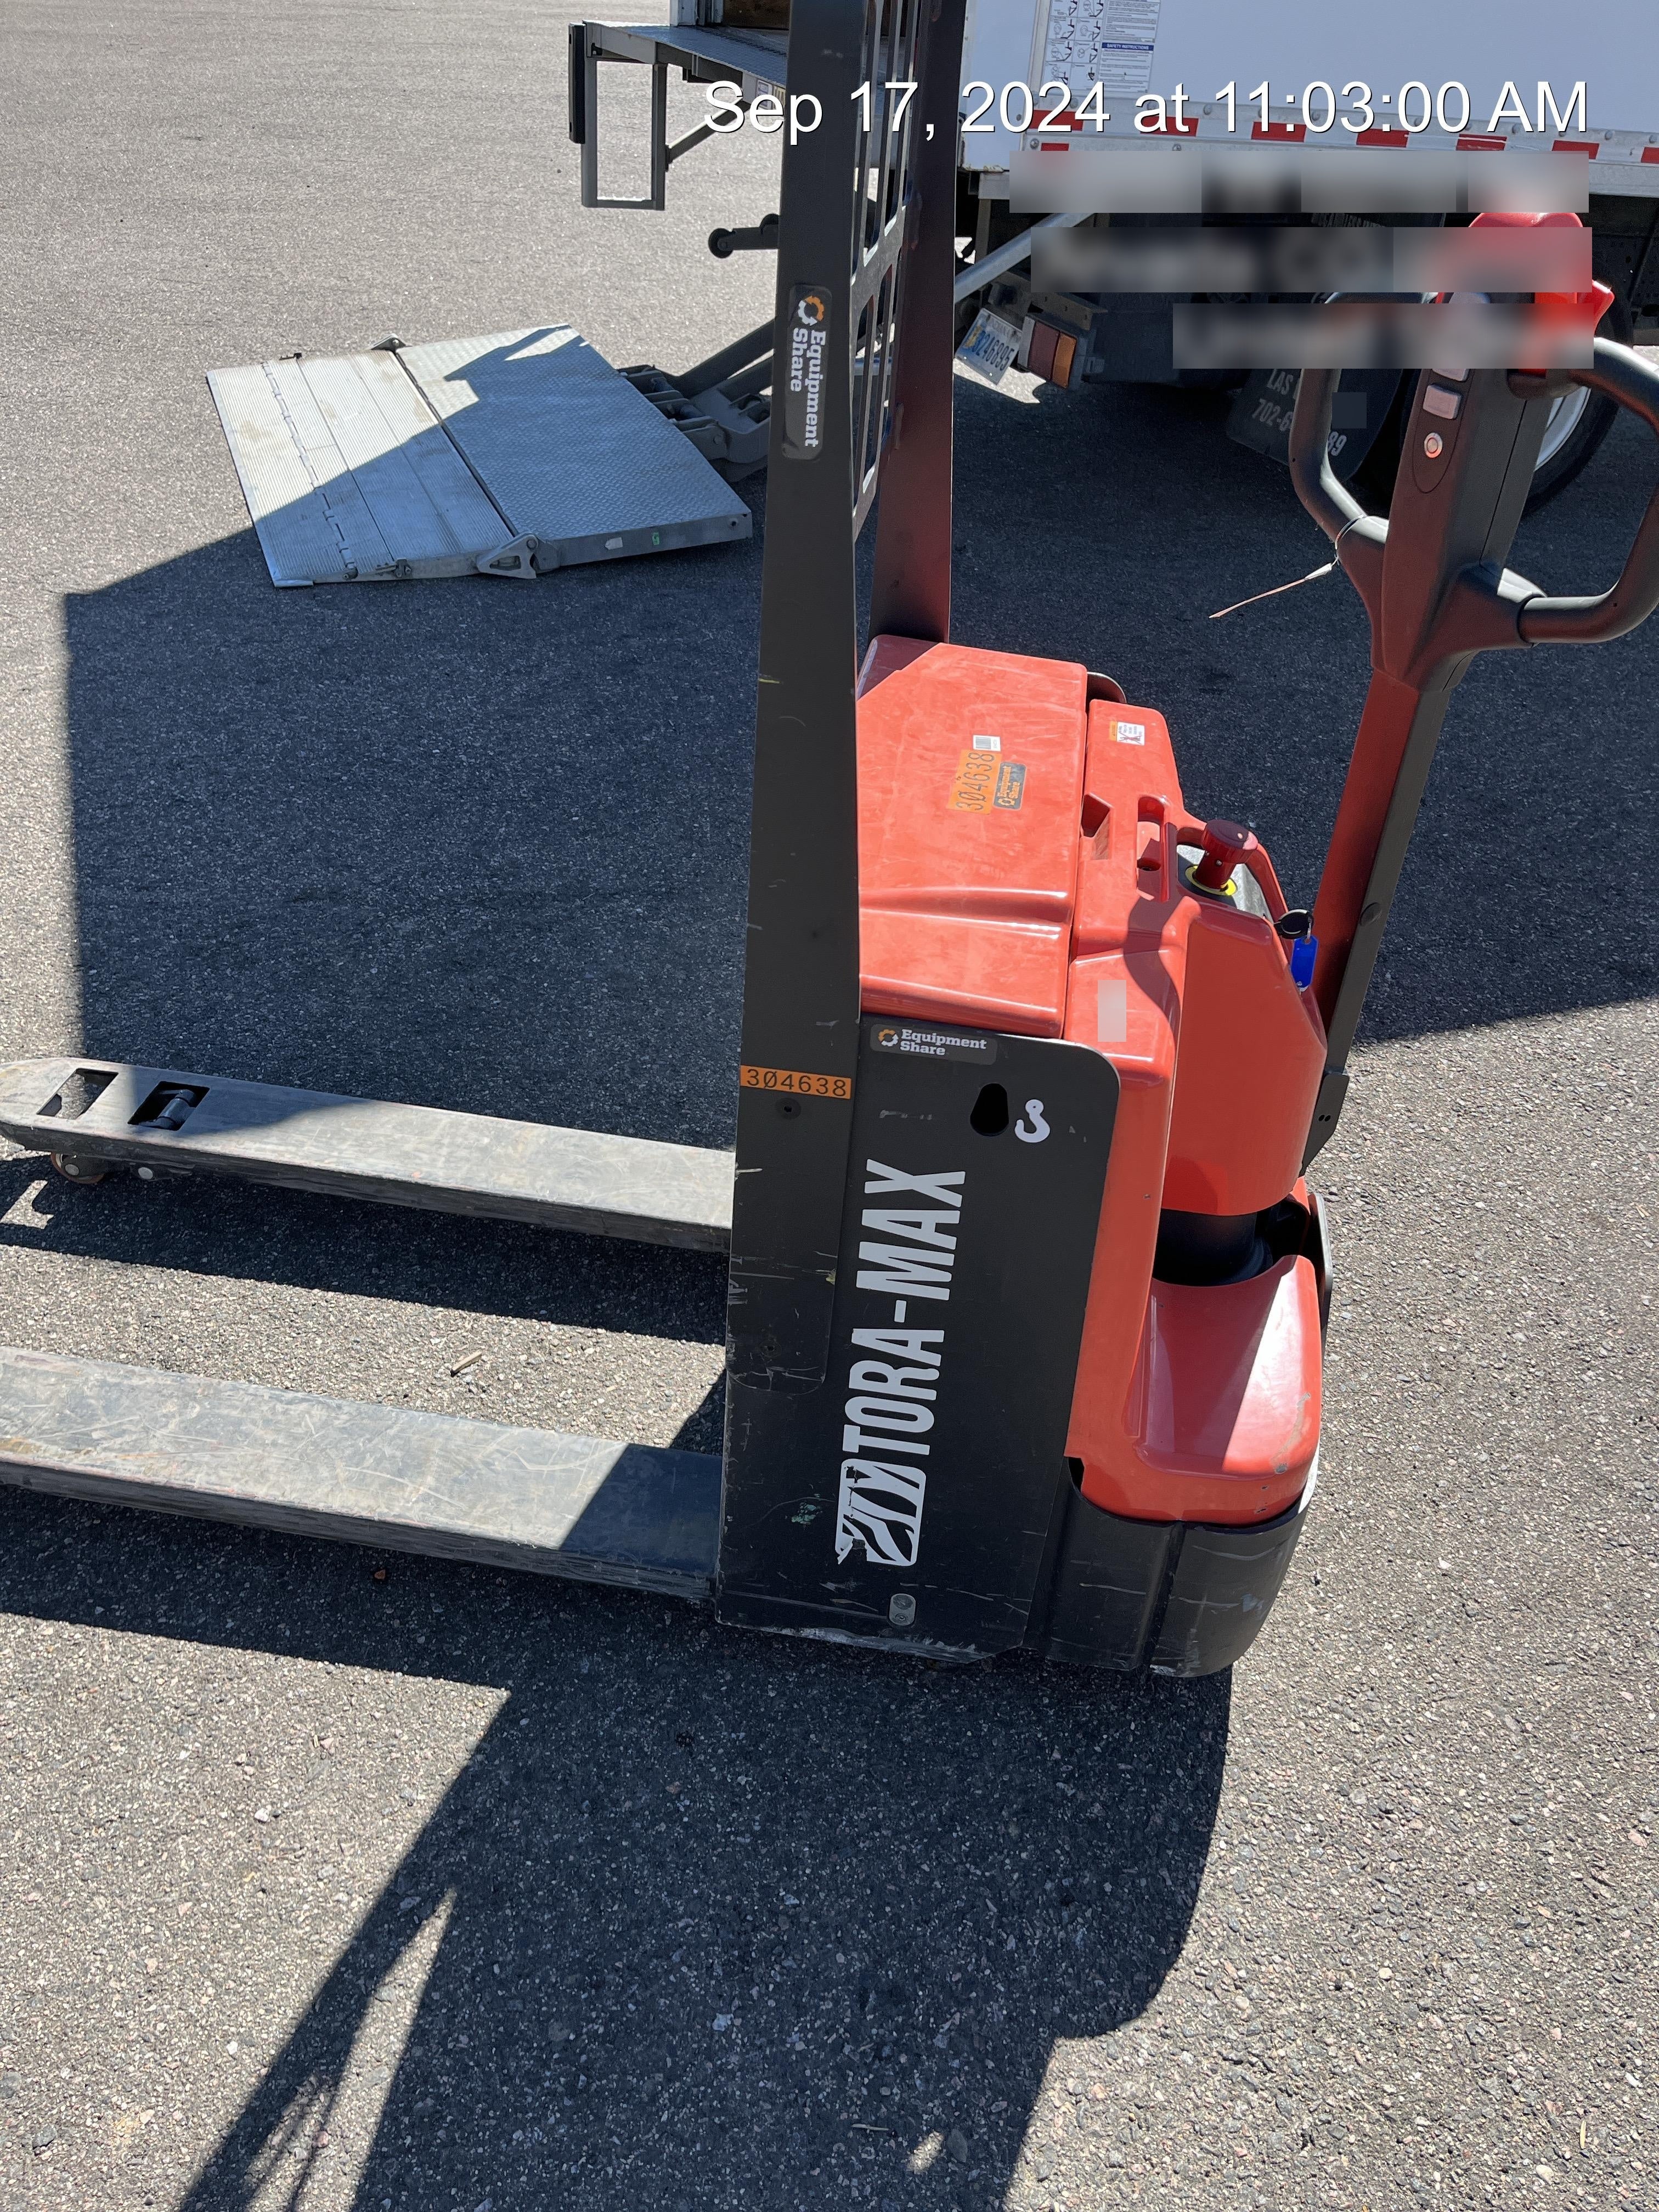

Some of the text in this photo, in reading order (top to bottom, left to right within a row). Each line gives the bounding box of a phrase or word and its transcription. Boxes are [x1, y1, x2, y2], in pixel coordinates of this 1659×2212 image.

[790, 328, 809, 393] Share
[804, 329, 826, 448] Equipment
[1266, 369, 1294, 396] LAS
[956, 752, 995, 810] 304638
[900, 1040, 946, 1056] Share
[901, 1029, 988, 1049] Equipment
[747, 1068, 847, 1097] 304638
[843, 1159, 966, 1455] TORA-MAX
